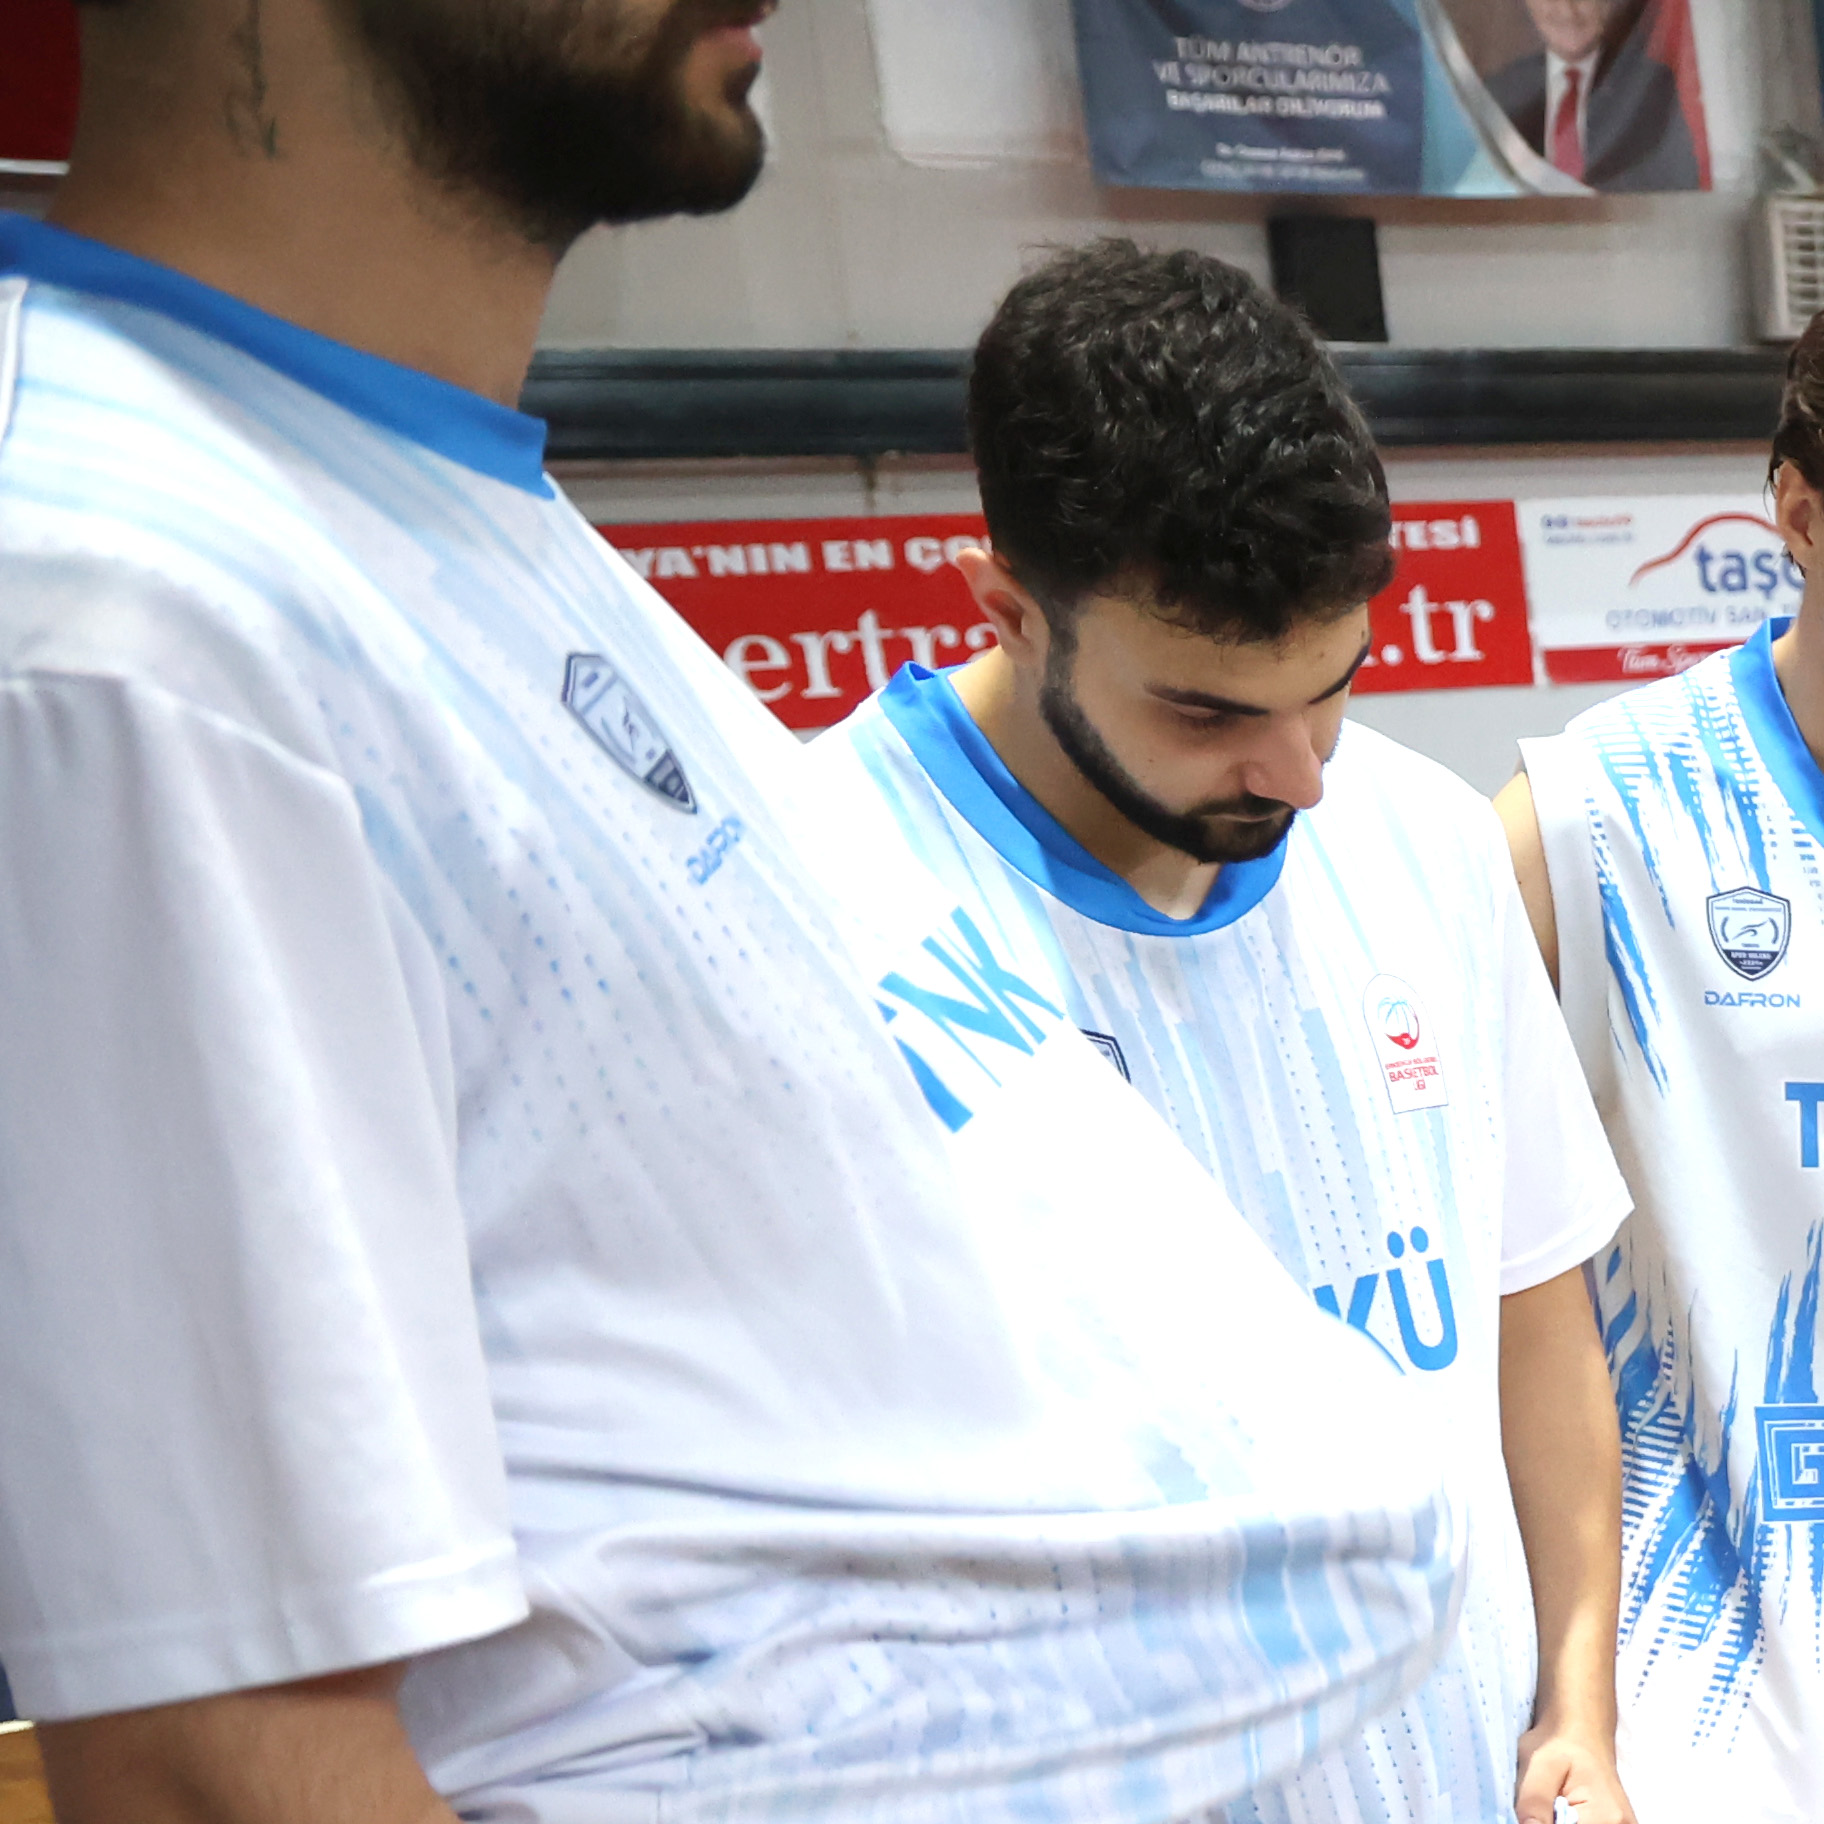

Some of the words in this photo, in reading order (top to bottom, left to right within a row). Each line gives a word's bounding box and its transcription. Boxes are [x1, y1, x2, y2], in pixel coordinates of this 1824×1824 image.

[617, 541, 810, 579] YA'NIN
[822, 539, 894, 573] EN
[904, 534, 993, 576] ÇO
[1704, 991, 1800, 1008] DAFRON
